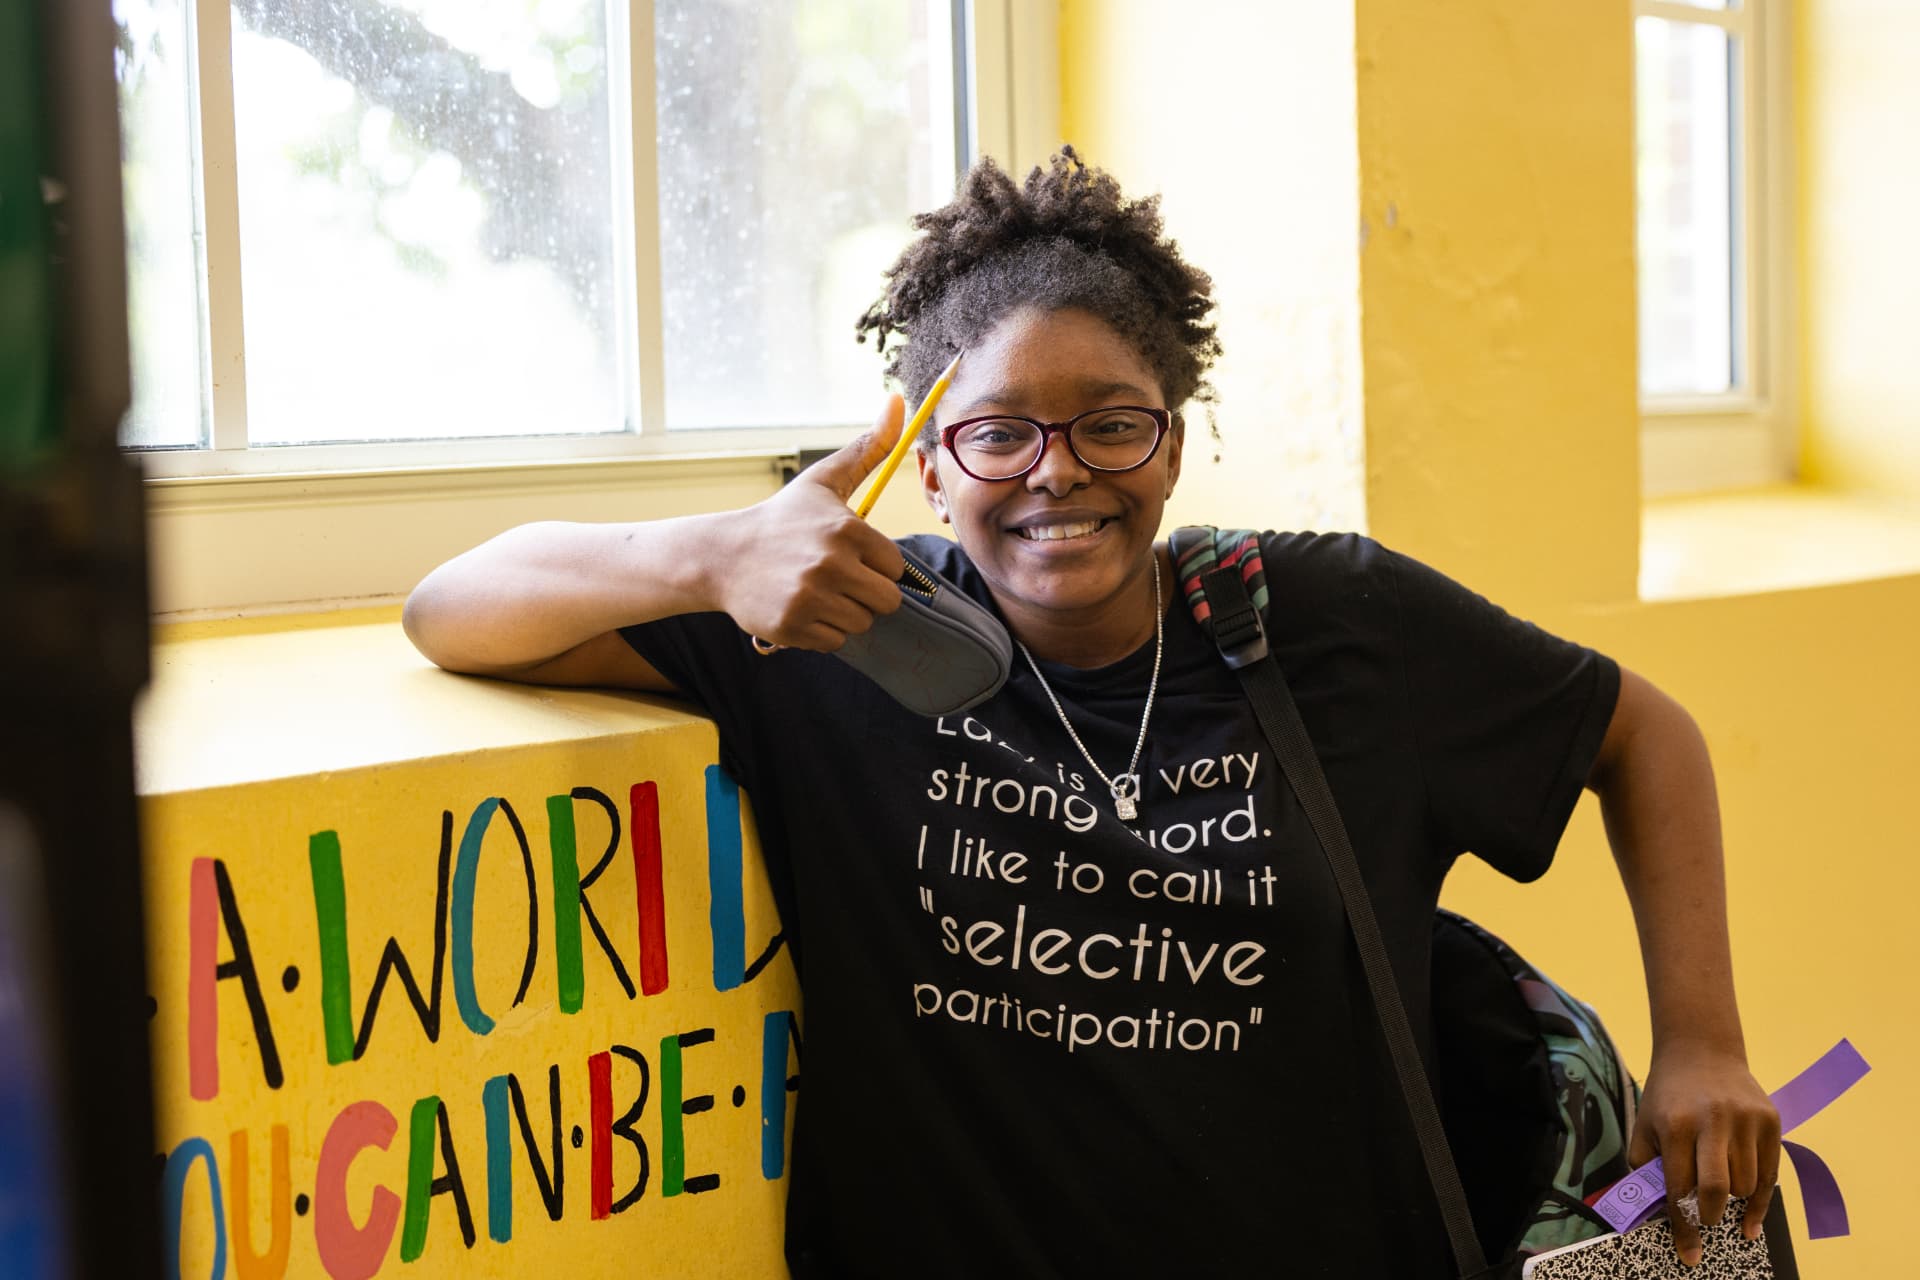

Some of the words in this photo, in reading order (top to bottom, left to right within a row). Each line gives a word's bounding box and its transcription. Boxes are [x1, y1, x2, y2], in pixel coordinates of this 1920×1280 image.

[926, 761, 1099, 833] strong
[936, 716, 1035, 763] La
[1056, 762, 1086, 792] is
[1109, 772, 1141, 802] a
[1159, 751, 1259, 795] very
[917, 824, 928, 870] I
[949, 828, 1029, 884] like
[1053, 850, 1105, 894] to
[1128, 868, 1222, 906] call
[1246, 865, 1278, 906] it
[187, 856, 283, 1101] A
[919, 885, 1267, 987] "selective
[913, 983, 1263, 1053] participation"
[158, 1124, 292, 1280] OU
[587, 1026, 720, 1221] BE
